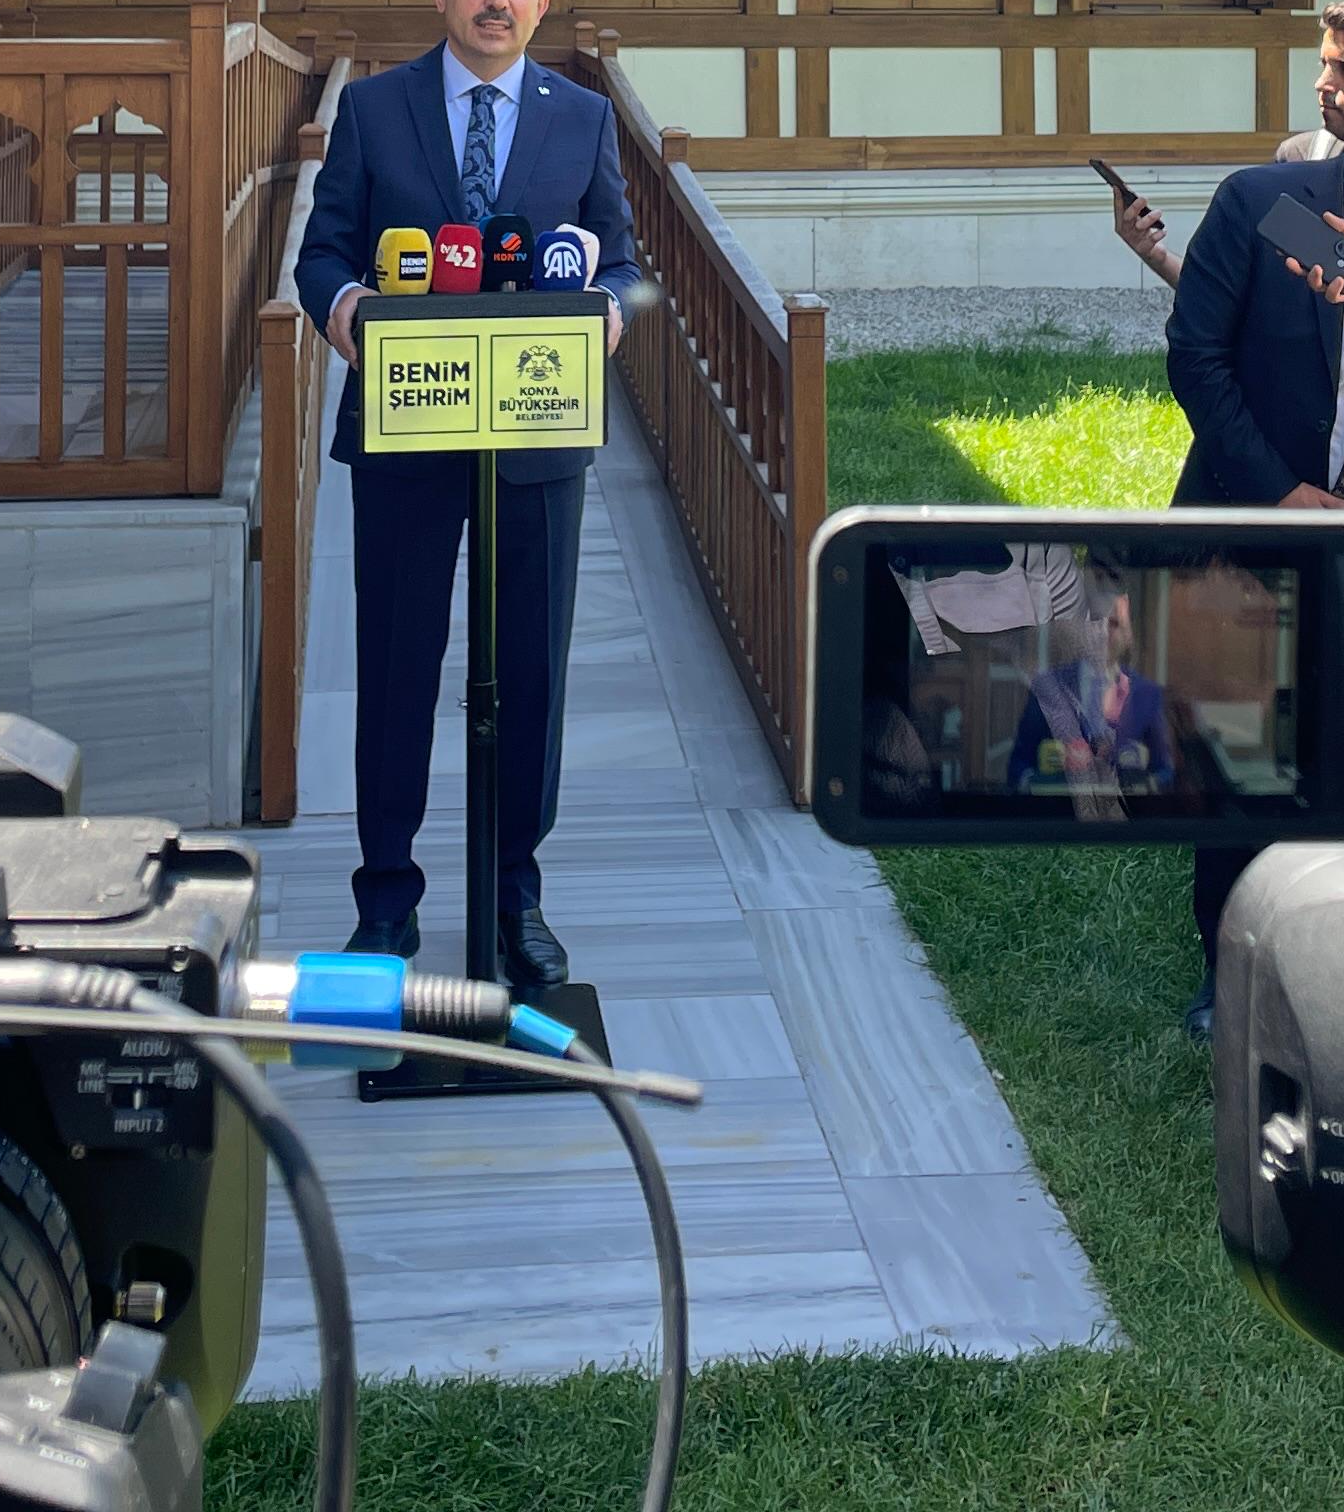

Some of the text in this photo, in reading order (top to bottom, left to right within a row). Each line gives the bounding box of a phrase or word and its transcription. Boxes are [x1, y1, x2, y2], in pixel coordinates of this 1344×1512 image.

[544, 250, 582, 279] AA
[519, 386, 560, 397] KONYA
[499, 396, 580, 412] BÜYÜKŞEHİR
[121, 1041, 169, 1057] AUDIO
[80, 1062, 105, 1076] MIC
[77, 1079, 105, 1094] LINE
[114, 1118, 164, 1133] INPUT 2
